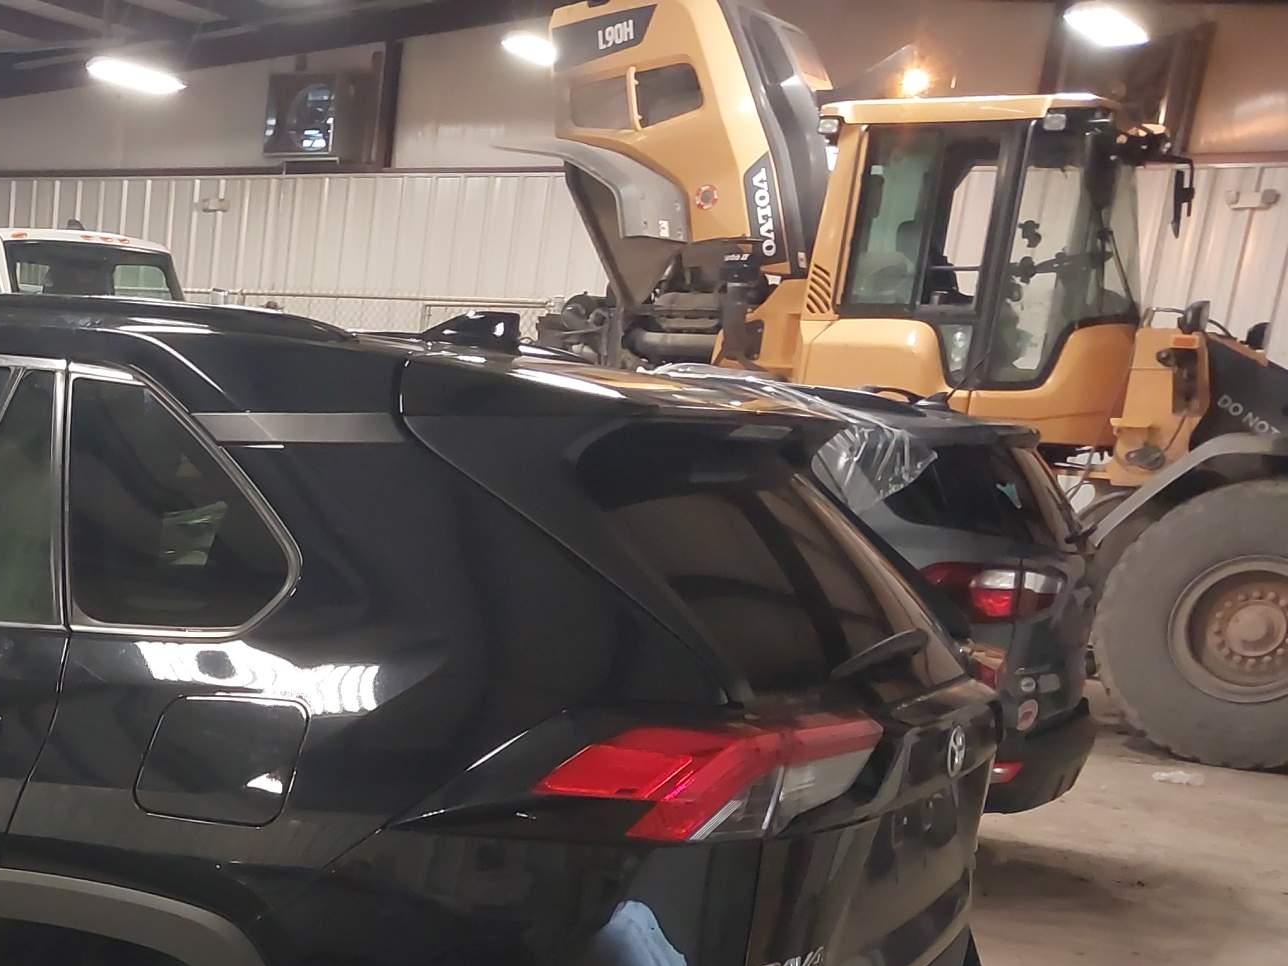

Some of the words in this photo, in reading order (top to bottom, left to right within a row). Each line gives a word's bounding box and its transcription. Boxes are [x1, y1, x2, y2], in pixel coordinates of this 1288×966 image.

[597, 19, 635, 50] L90H
[751, 167, 777, 257] VOLVO
[1217, 394, 1244, 416] DO
